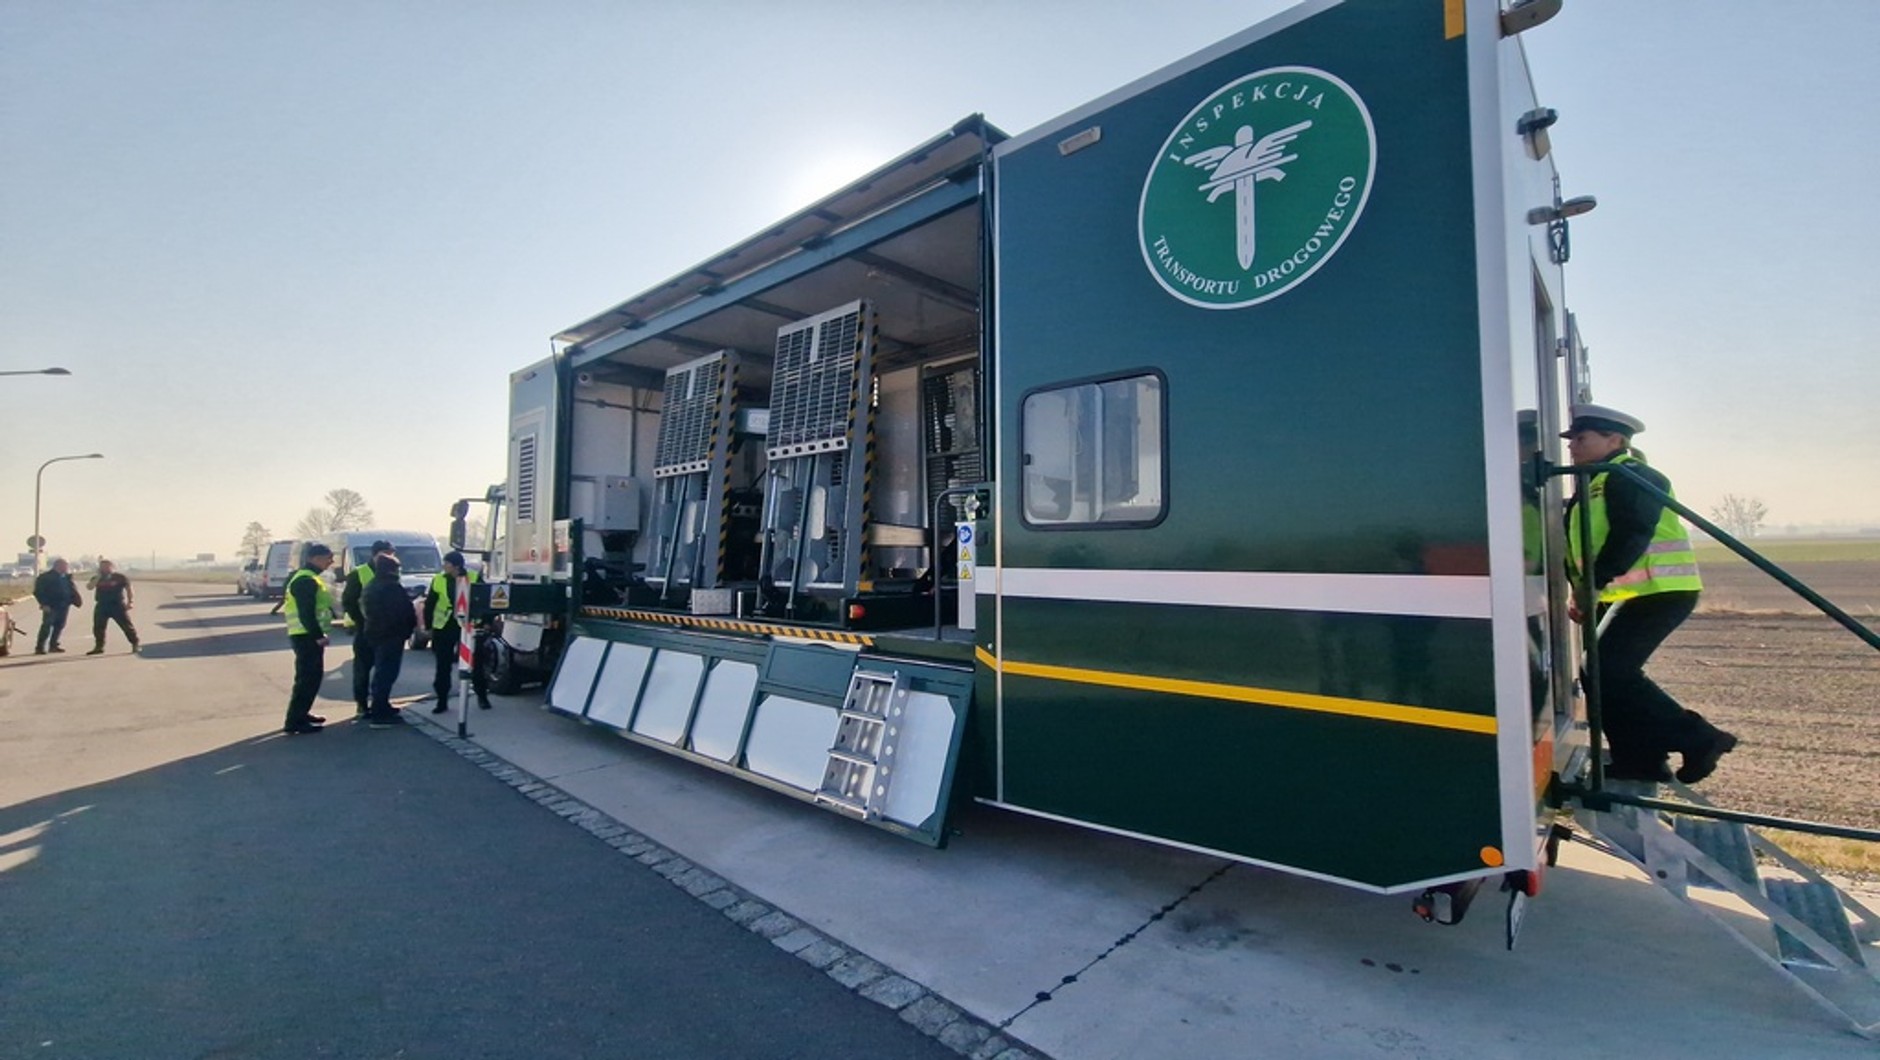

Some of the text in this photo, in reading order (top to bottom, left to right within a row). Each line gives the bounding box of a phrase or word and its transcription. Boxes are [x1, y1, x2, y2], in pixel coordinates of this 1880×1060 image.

[1169, 82, 1325, 162] INSPEKCJA
[1153, 176, 1356, 295] TRANSPORTU DROGOWEGO
